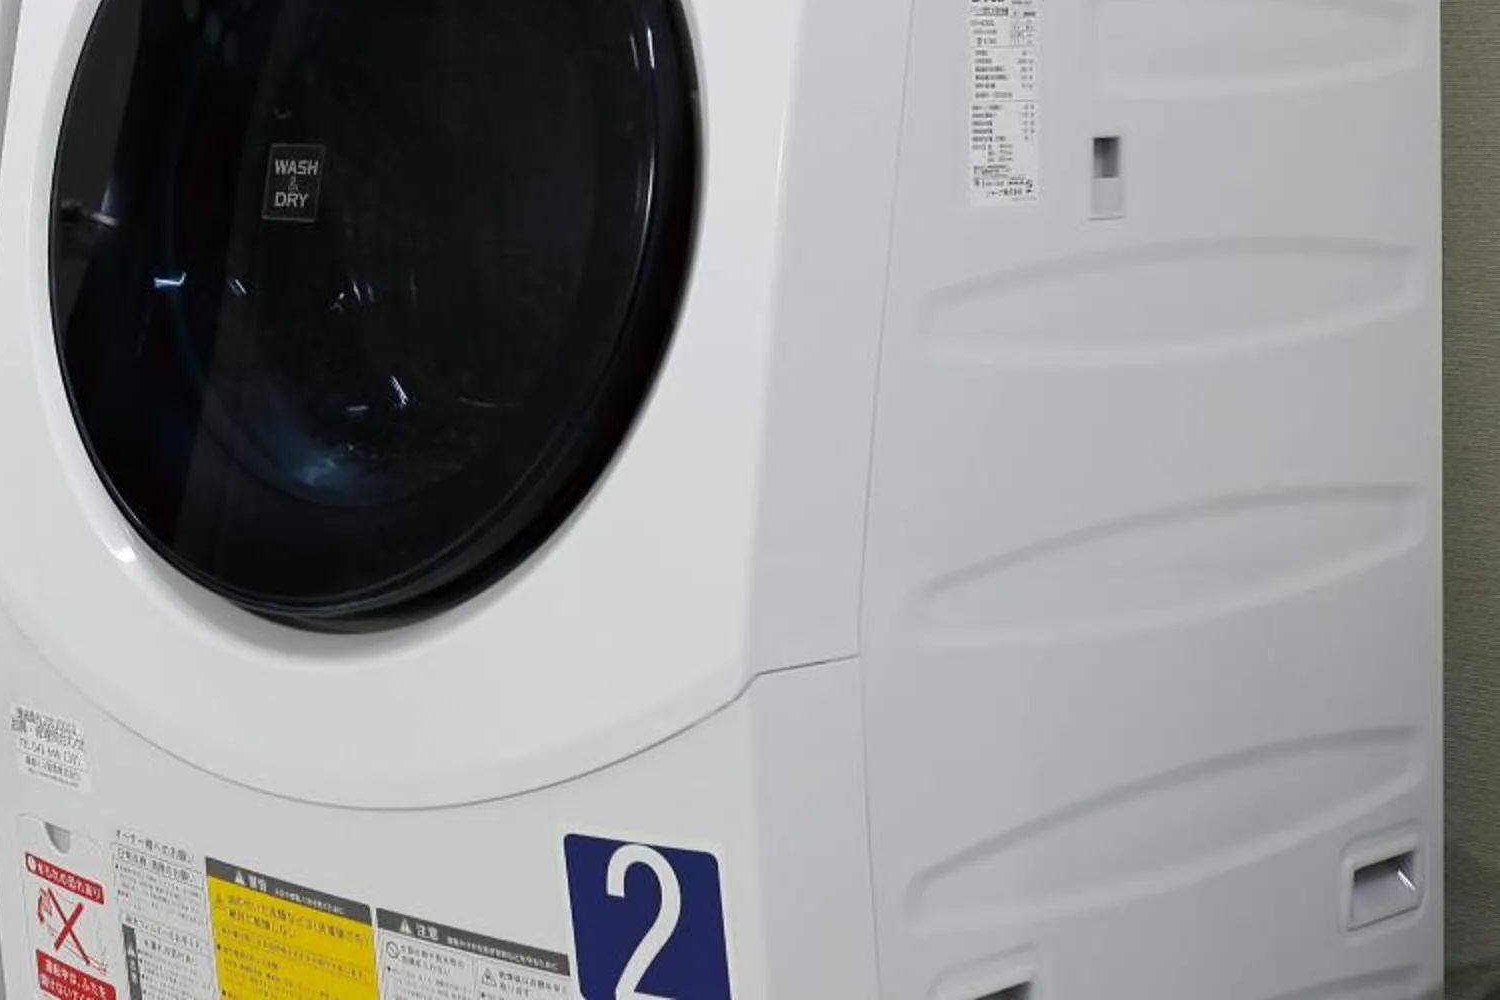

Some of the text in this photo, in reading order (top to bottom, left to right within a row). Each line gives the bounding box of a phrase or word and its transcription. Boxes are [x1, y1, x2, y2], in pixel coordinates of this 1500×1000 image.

[274, 159, 319, 176] WASH
[274, 191, 309, 208] DRY
[605, 843, 681, 1000] 2
